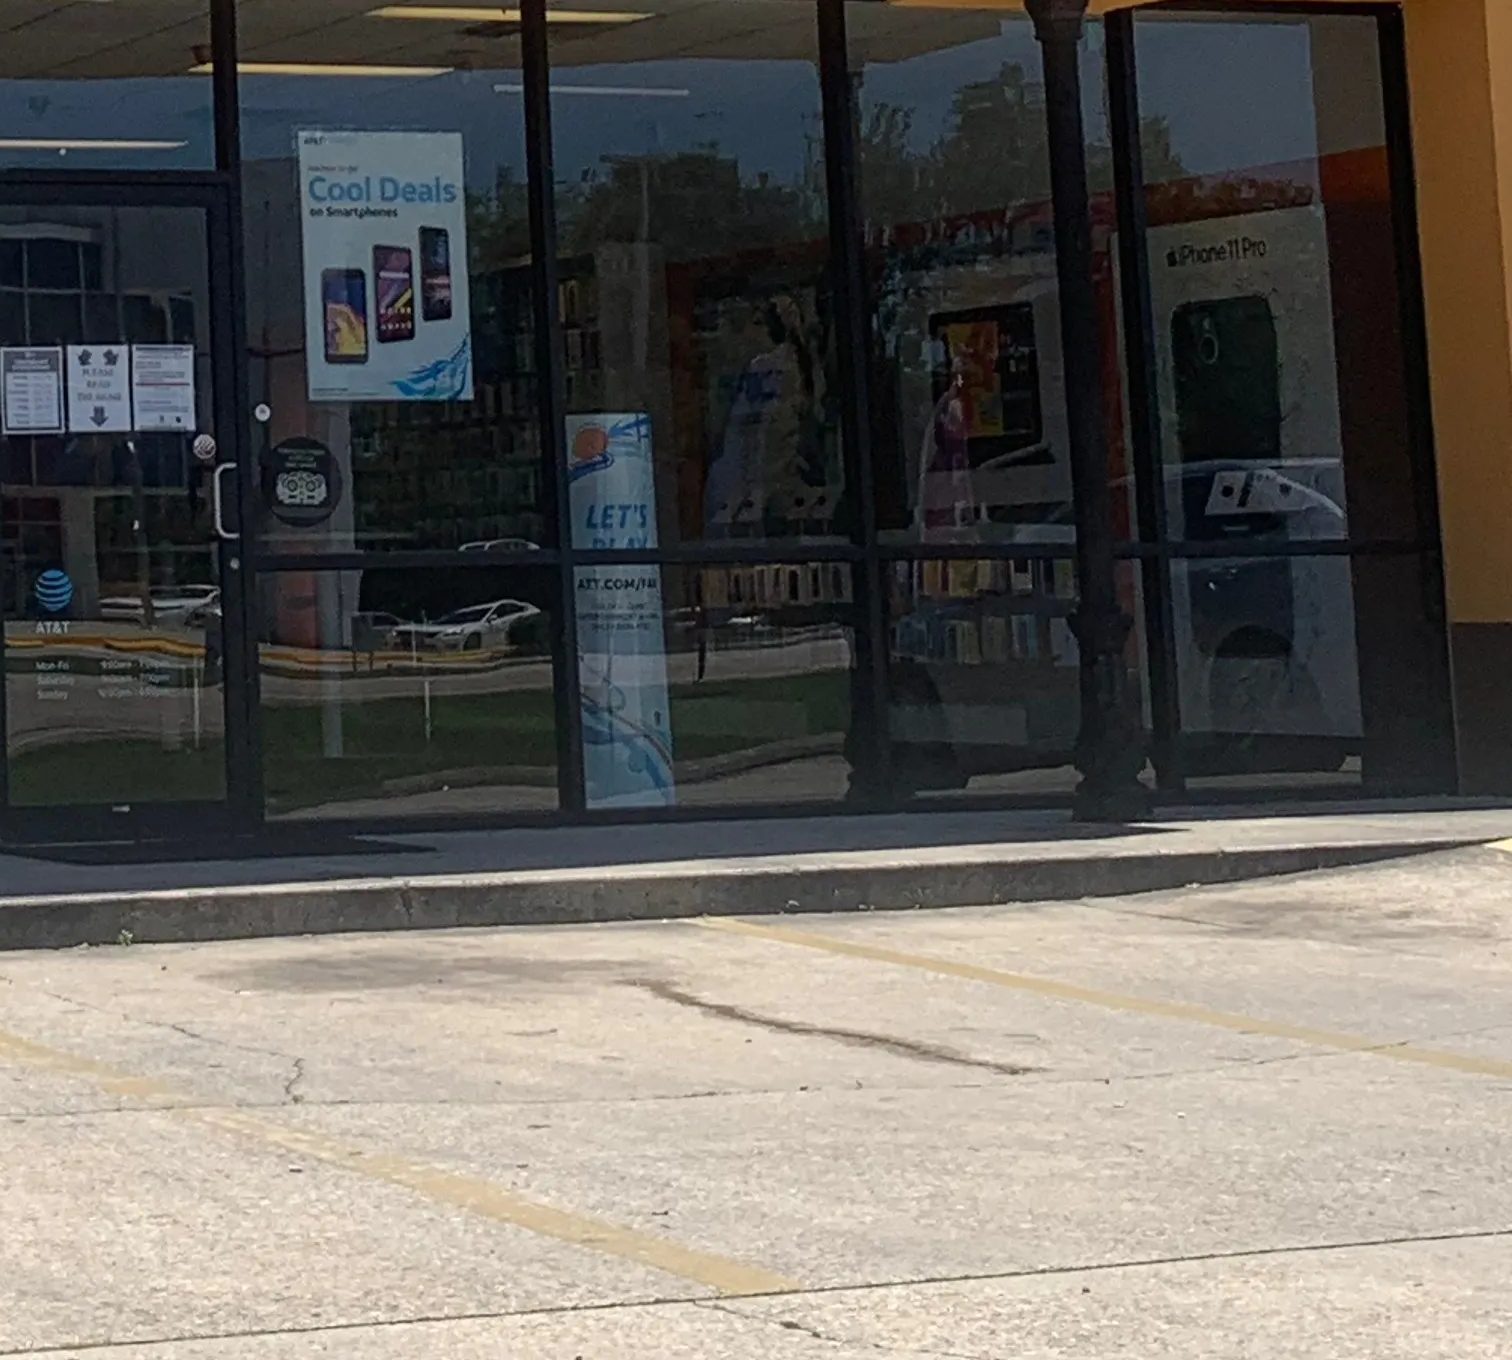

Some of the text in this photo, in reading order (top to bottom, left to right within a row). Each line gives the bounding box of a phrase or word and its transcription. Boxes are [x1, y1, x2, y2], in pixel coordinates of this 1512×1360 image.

[308, 175, 457, 203] Cool Deals
[309, 206, 398, 219] on Smartphones
[1178, 243, 1227, 265] iPhone
[1242, 237, 1267, 259] Pro
[586, 504, 647, 528] LET'S
[35, 621, 70, 634] AT&T
